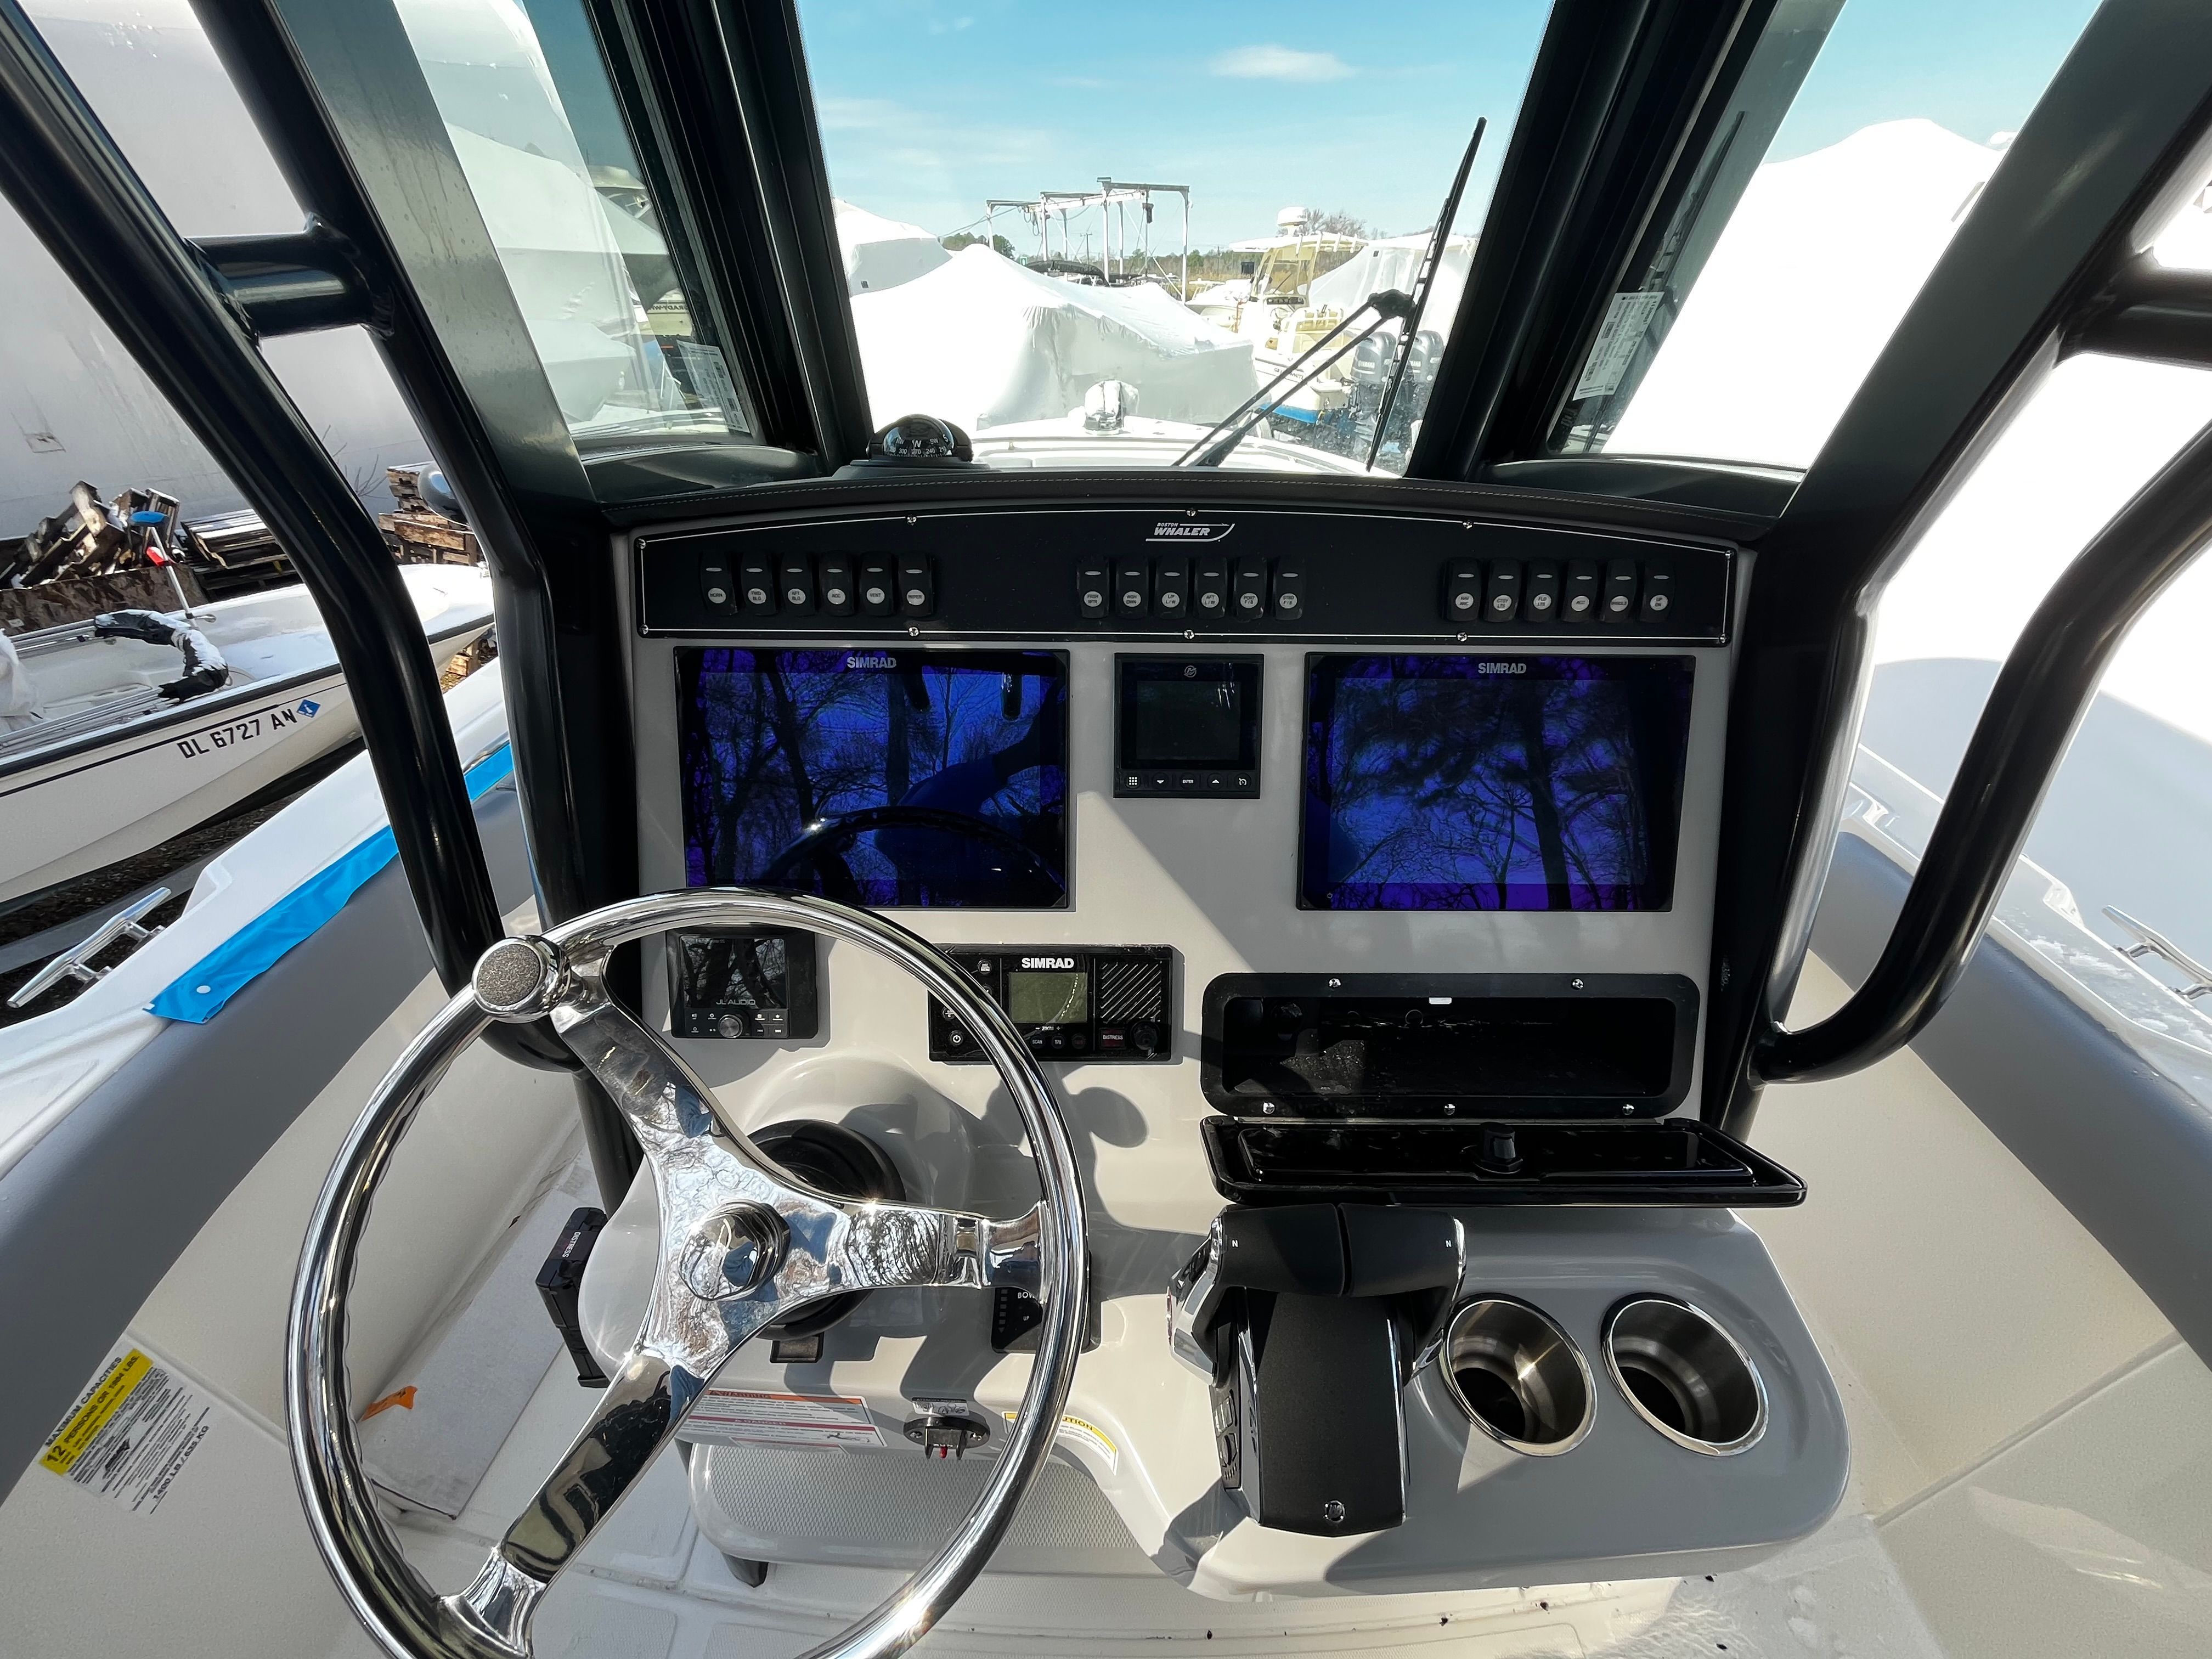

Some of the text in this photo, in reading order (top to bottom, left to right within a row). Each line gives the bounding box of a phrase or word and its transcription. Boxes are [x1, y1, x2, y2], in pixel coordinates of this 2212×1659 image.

[1154, 527, 1210, 535] WHALER
[847, 657, 897, 668] SIMRAD
[1478, 663, 1527, 674] SIMRAD
[177, 708, 298, 759] DL 6727 AN
[1022, 957, 1074, 969] SIMRAD
[562, 1232, 581, 1257] DISTRESS
[44, 1404, 82, 1447] MAXIMUM
[80, 1356, 122, 1404] CAPACITIES
[47, 1445, 67, 1463] 12
[63, 1404, 99, 1443] PERSONS
[97, 1390, 110, 1404] OR
[1062, 1417, 1093, 1431] UTION
